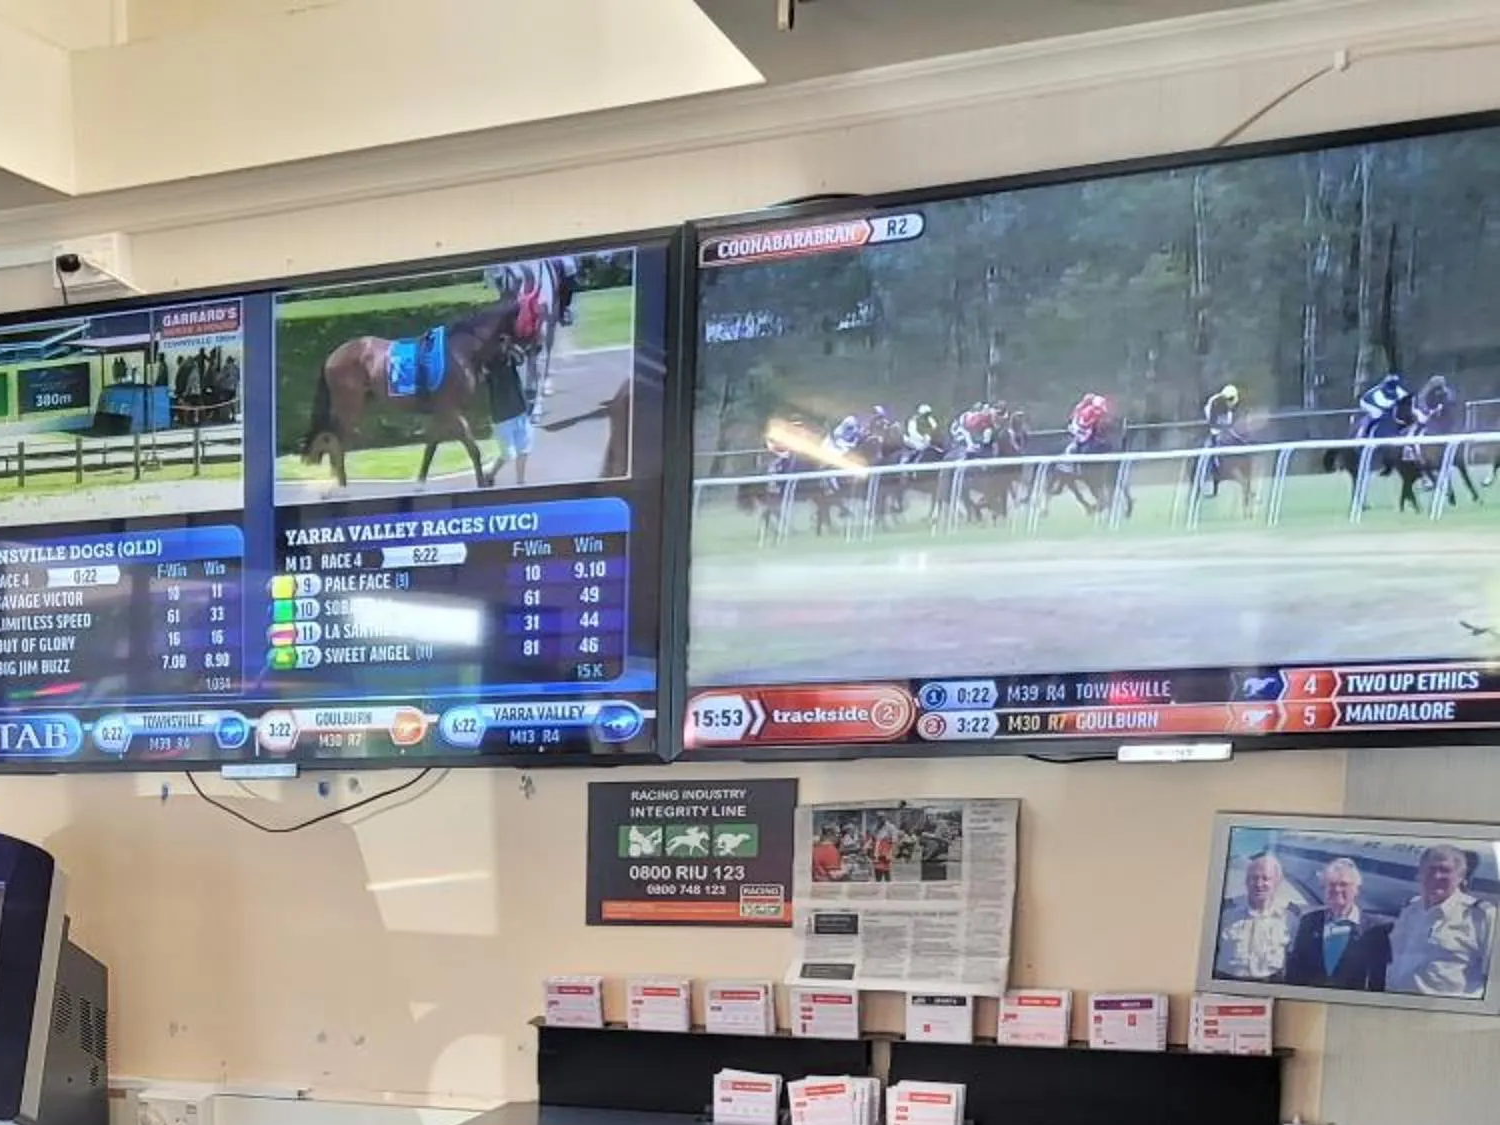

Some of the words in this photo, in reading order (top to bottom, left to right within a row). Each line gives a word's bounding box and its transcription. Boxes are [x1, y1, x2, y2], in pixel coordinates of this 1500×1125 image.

[718, 224, 855, 258] COONABARABRAN
[887, 220, 907, 237] R2
[35, 393, 73, 407] 380m
[285, 526, 346, 546] YARRA
[349, 521, 418, 542] VALLEY
[421, 518, 485, 537] RACES
[489, 513, 539, 534] (VIC)
[69, 543, 115, 563] DOGS
[118, 539, 162, 562] (QLD)
[513, 541, 551, 558] F-Win
[574, 538, 603, 553] Win
[203, 561, 226, 576] Win
[321, 554, 352, 570] RACE
[353, 553, 361, 568] 4
[573, 560, 607, 578] 9.10
[22, 573, 29, 586] 4
[325, 575, 358, 592] PALE
[359, 573, 391, 590] FACE
[44, 591, 83, 607] VICTOR
[523, 588, 540, 607] 61
[579, 586, 599, 604] 49
[167, 609, 180, 624] 61
[210, 607, 224, 621] 33
[300, 600, 313, 618] 10
[56, 614, 92, 629] SPEED
[524, 613, 540, 631] 31
[579, 611, 600, 628] 44
[302, 624, 313, 641] 11
[325, 623, 340, 640] LA
[22, 638, 37, 652] OF
[39, 636, 76, 652] GLORY
[578, 637, 599, 654] 46
[300, 647, 315, 665] 12
[325, 646, 367, 663] SWEET
[369, 643, 411, 661] ANGEL
[19, 660, 38, 677] JIM
[41, 659, 70, 674] BUZZ
[1303, 676, 1317, 693] 4
[1346, 676, 1384, 693] TWO
[1390, 674, 1415, 691] UP
[1416, 671, 1479, 690] ETHICS
[956, 687, 990, 704] 0:22
[1007, 685, 1039, 702] M39
[1045, 684, 1066, 701] R4
[1075, 681, 1171, 700] TOWNSVILLE
[142, 714, 204, 728] TOWNSVILLE
[315, 710, 373, 726] GOULBURN
[493, 707, 534, 720] YARRA
[536, 705, 586, 720] VALLEY
[692, 709, 743, 728] 15:53
[772, 706, 869, 725] trackside
[1303, 708, 1315, 725] 5
[1345, 701, 1456, 723] MANDALORE
[268, 722, 291, 738] 3:22
[452, 718, 477, 734] 6:22
[956, 717, 990, 734] 3:22
[1007, 715, 1041, 732] M30
[1047, 713, 1068, 730] R7
[1075, 712, 1160, 730] GOULBURN
[509, 729, 535, 745] M13
[541, 728, 560, 743] R4
[631, 790, 679, 801] RACING
[682, 789, 747, 799] INDUSTRY
[630, 806, 709, 817] INTEGRITY
[712, 806, 747, 816] LINE
[629, 866, 671, 880] 0800
[676, 865, 708, 880] RIU
[712, 865, 744, 880] 123
[647, 884, 676, 895] 0800
[705, 884, 726, 894] 123
